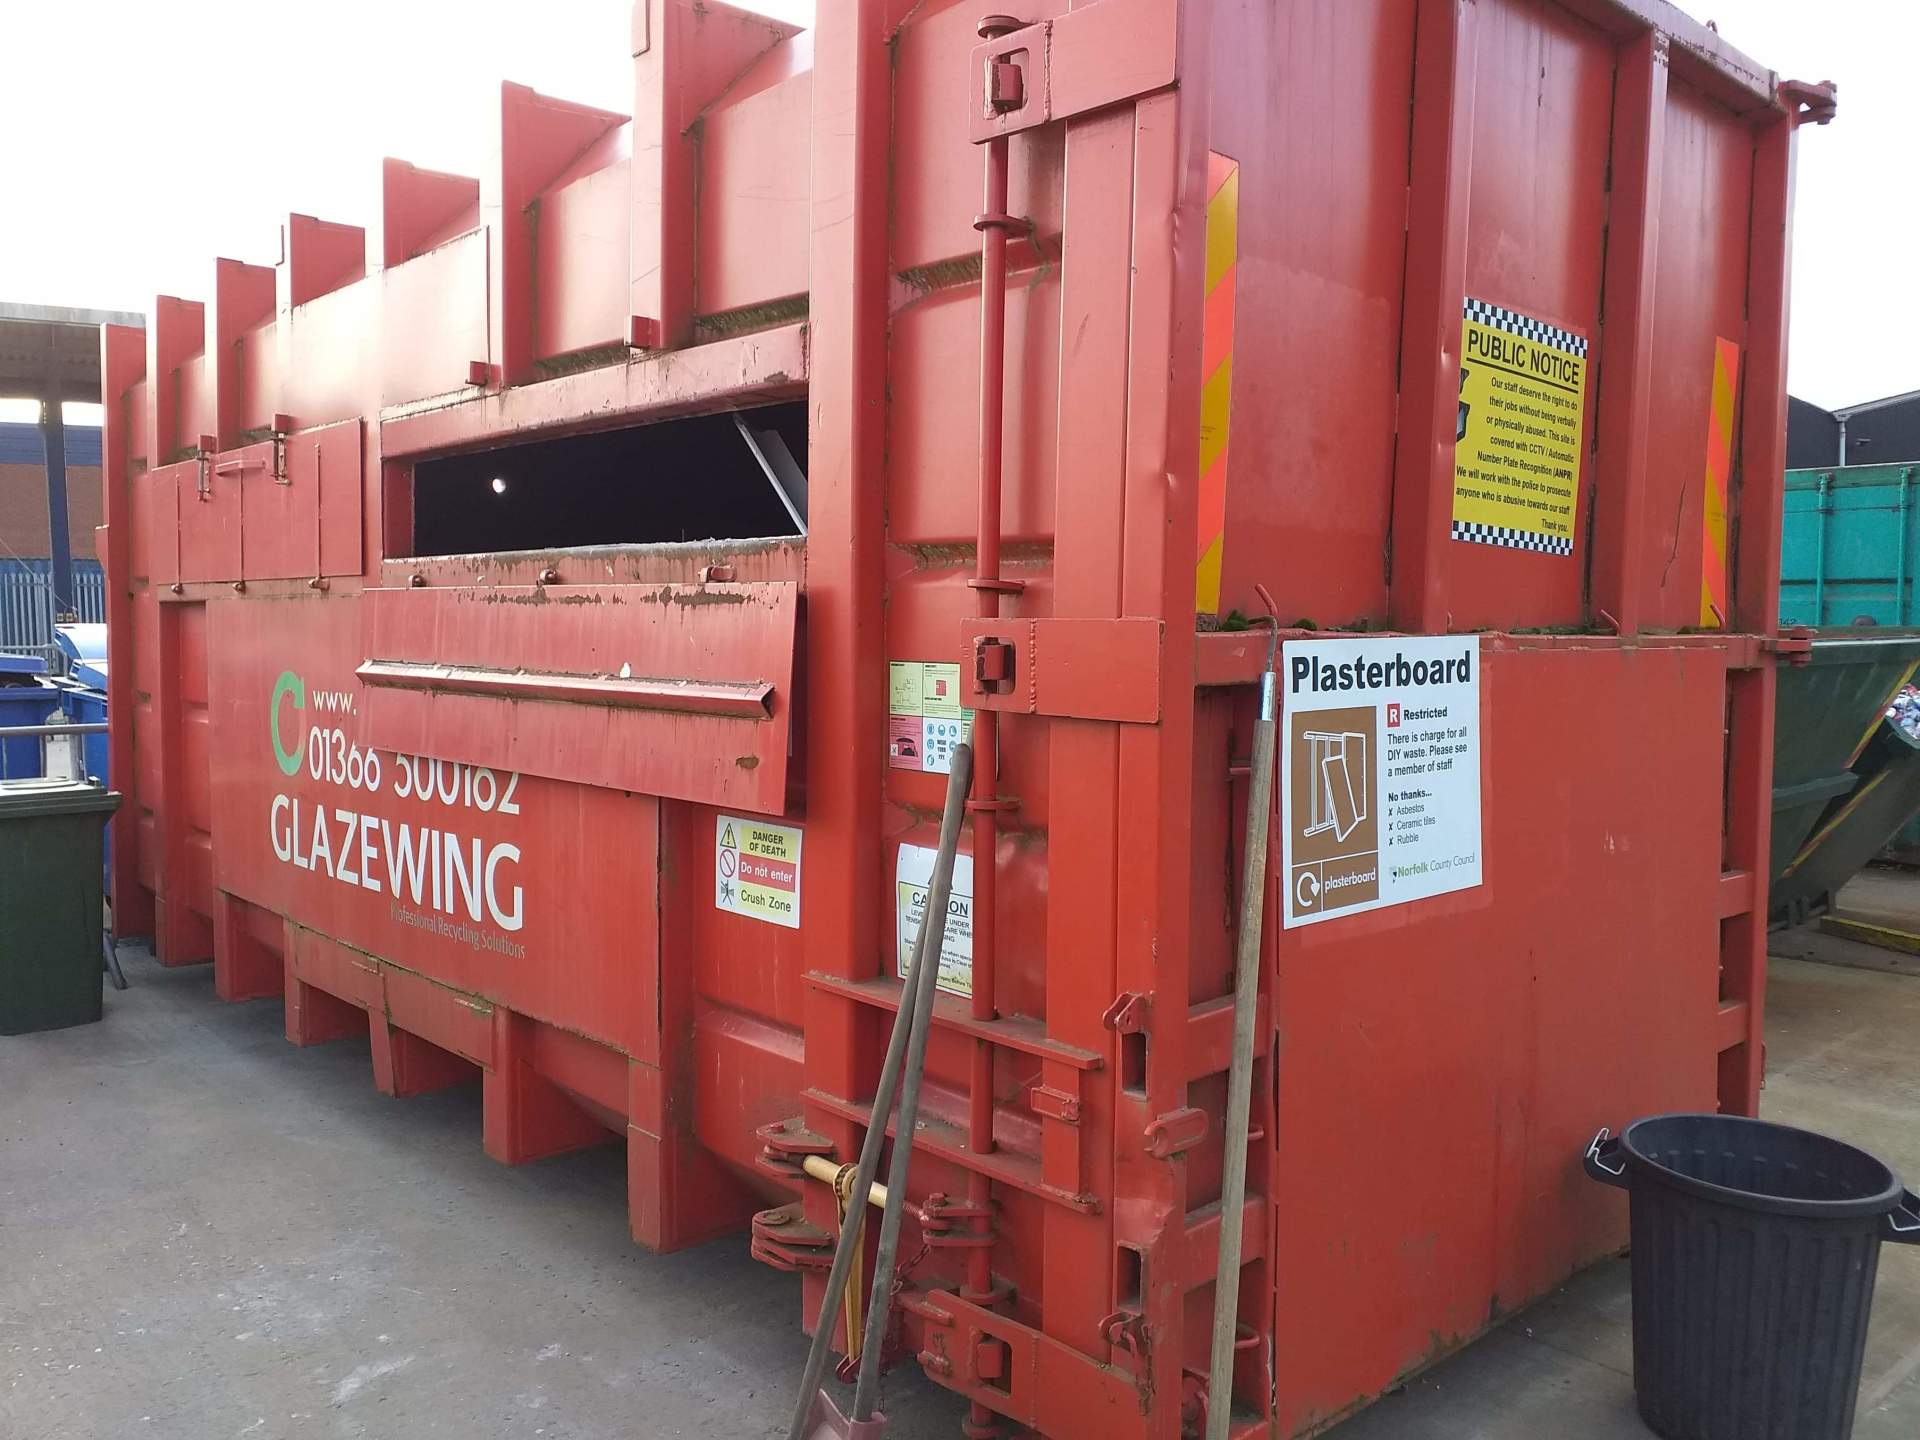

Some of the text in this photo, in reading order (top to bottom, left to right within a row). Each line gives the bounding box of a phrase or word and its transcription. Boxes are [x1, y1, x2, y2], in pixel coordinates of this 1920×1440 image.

[1468, 329, 1580, 385] PUBLIC NOTICE
[1492, 377, 1577, 410] Our staff deserve the right to do
[1490, 396, 1576, 430] their jobs without being verbally
[1495, 417, 1524, 434] physically
[1526, 425, 1546, 438] abused.
[1549, 430, 1560, 440] This
[1560, 434, 1569, 444] site
[1490, 436, 1514, 448] covered
[1516, 440, 1528, 453] with
[1529, 445, 1545, 456] CCTV
[1549, 448, 1574, 463] Automatic
[1478, 450, 1572, 482] Number Plate Recognition (ANPR)
[1456, 465, 1571, 497] We will work with the police to prosecute
[1456, 486, 1570, 516] anyone who is abusive towards our staff
[1542, 518, 1556, 529] Thank
[1292, 650, 1470, 693] Plasterboard
[1404, 706, 1448, 720] Restricted
[1388, 734, 1409, 745] There
[1412, 732, 1418, 742] is
[1420, 730, 1445, 743] charge
[1447, 728, 1456, 738] for
[309, 726, 381, 792] 01366
[1388, 744, 1467, 760] DIY waste. Please see
[1395, 763, 1425, 776] member
[1428, 760, 1435, 772] of
[1437, 758, 1453, 770] staff
[1388, 788, 1432, 802] No thanks...
[1397, 804, 1424, 816] Asbestos
[1397, 816, 1435, 830] Ceramic tiles
[753, 831, 783, 845] DANGER
[1397, 833, 1419, 845] Rubble
[750, 842, 786, 858] OF DEATH
[271, 794, 522, 930] GLAZEWING
[741, 862, 792, 883] Do not enter
[1398, 852, 1474, 877] Norfolk County Council
[1325, 866, 1376, 894] plasterboard
[741, 889, 791, 912] Crush Zone
[912, 892, 968, 915] CAON
[391, 898, 525, 959] Professional Recycling Solutions
[950, 919, 969, 928] UNDER
